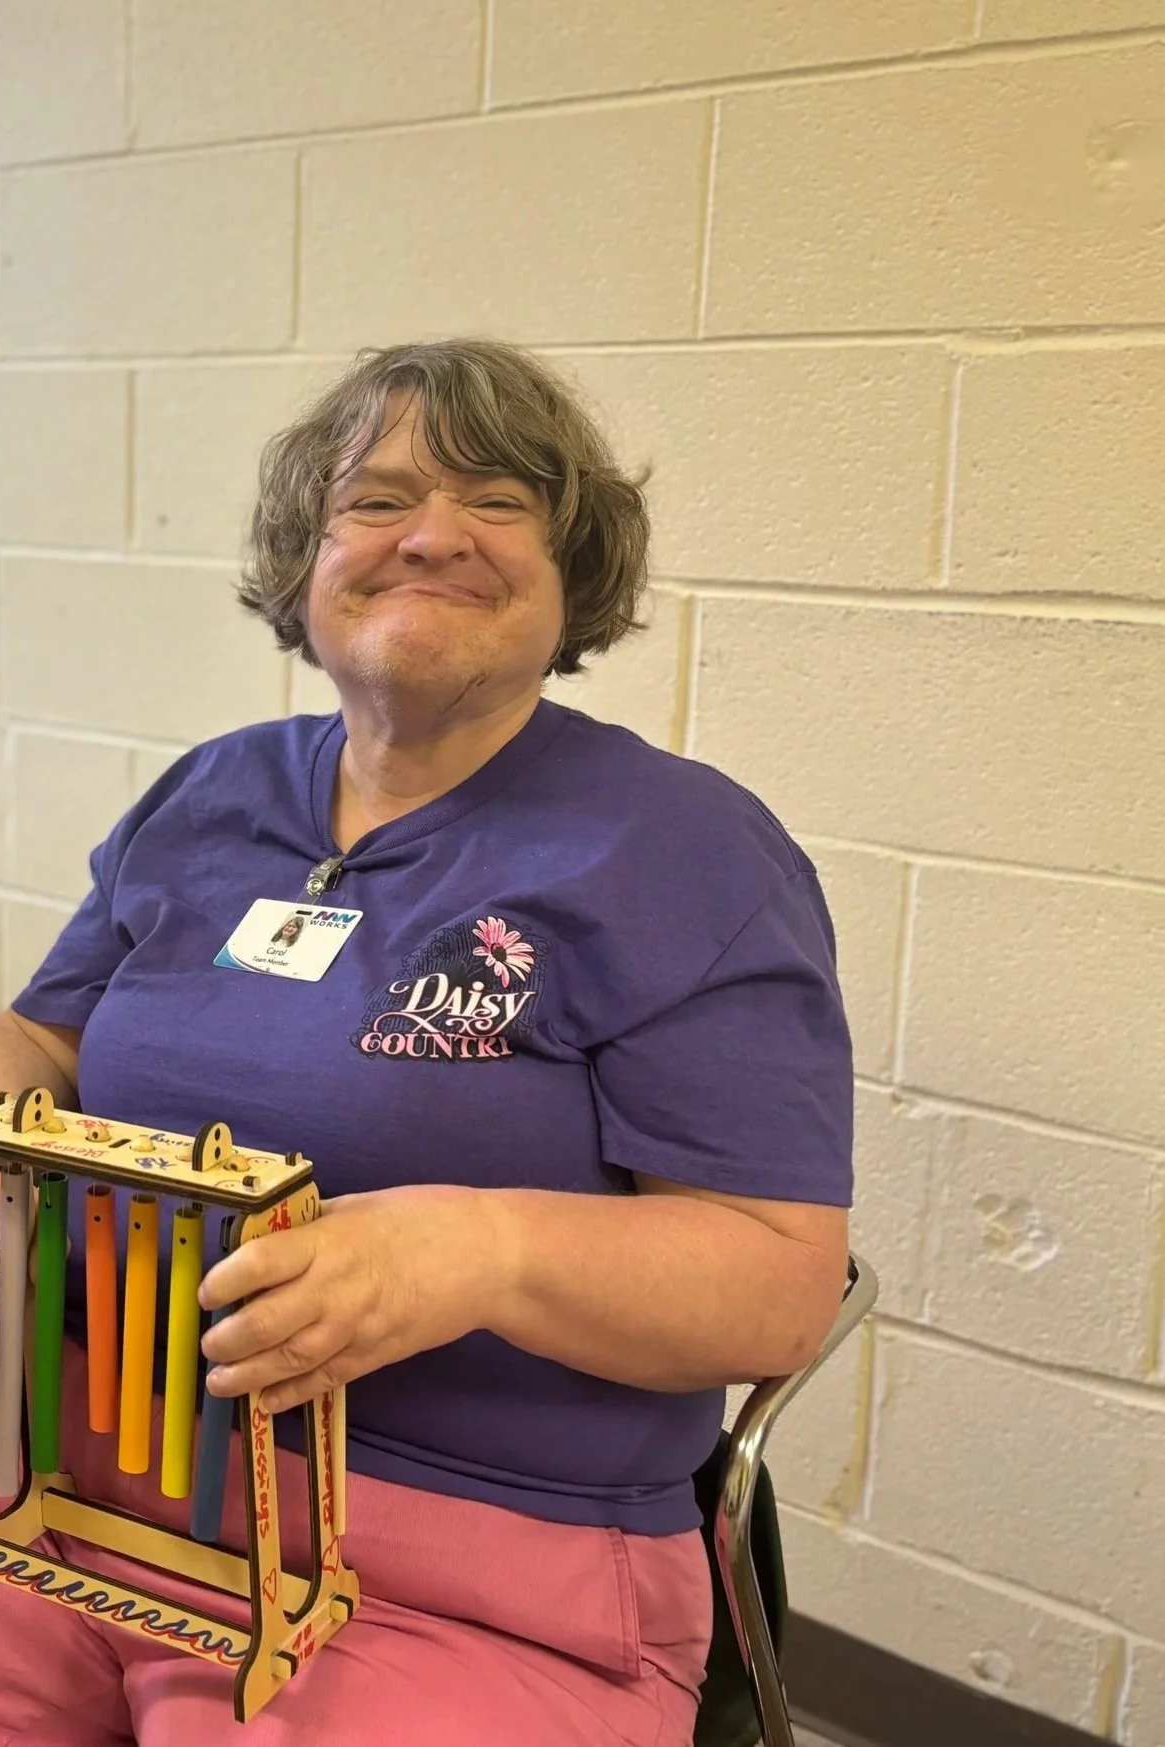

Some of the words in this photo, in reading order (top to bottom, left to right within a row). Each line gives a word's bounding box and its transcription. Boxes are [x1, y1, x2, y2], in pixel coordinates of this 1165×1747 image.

[310, 919, 348, 930] WORKS
[266, 946, 288, 957] Carol
[252, 955, 267, 963] Team
[267, 958, 290, 967] Member
[252, 1407, 270, 1540] Blessings
